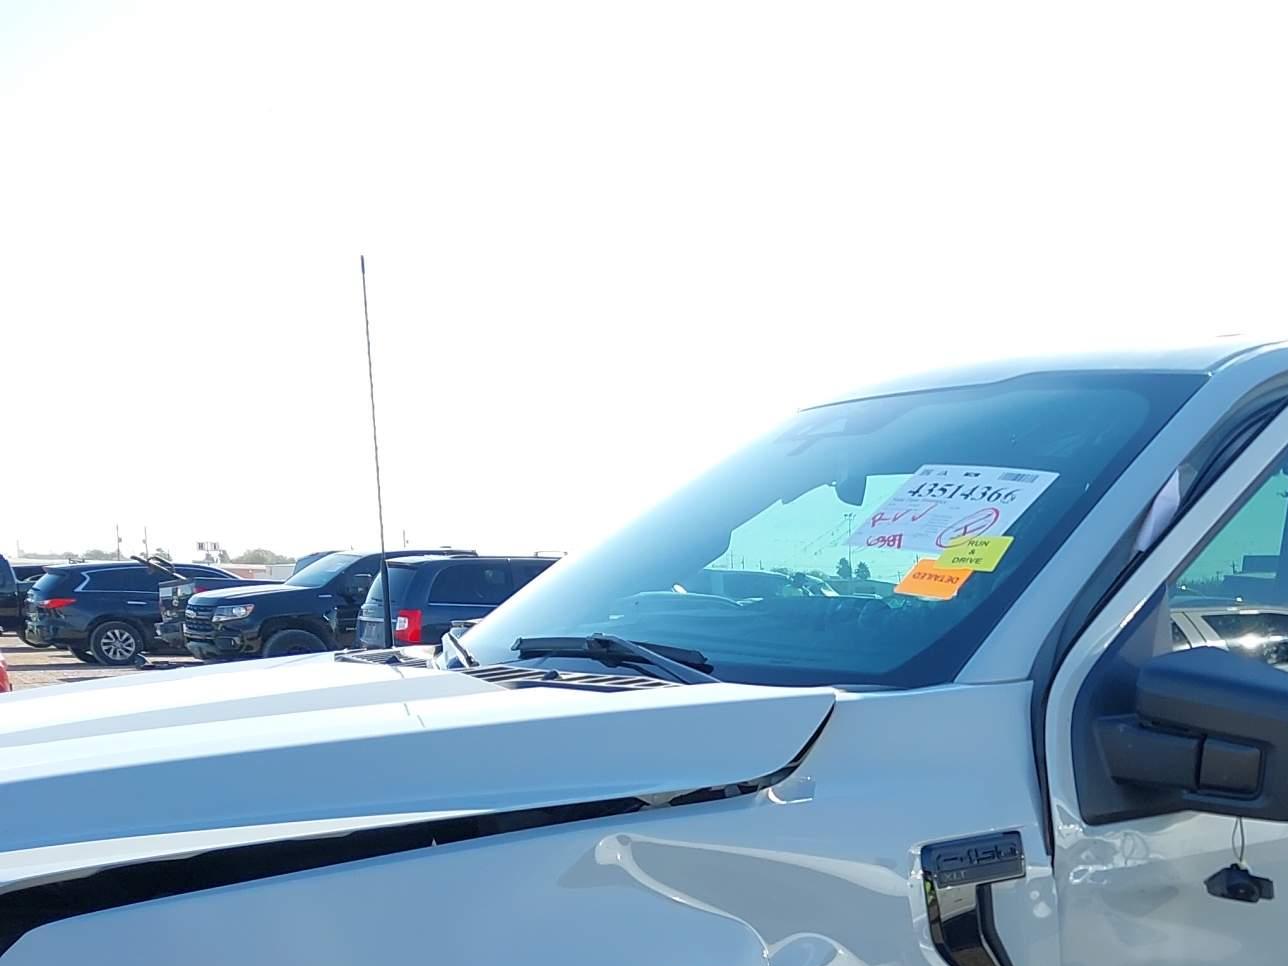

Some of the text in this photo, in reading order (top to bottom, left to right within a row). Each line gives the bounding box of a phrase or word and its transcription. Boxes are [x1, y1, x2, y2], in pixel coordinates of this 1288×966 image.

[908, 481, 1020, 504] 43514366
[951, 556, 984, 564] DRIVE
[943, 871, 967, 882] XLT
